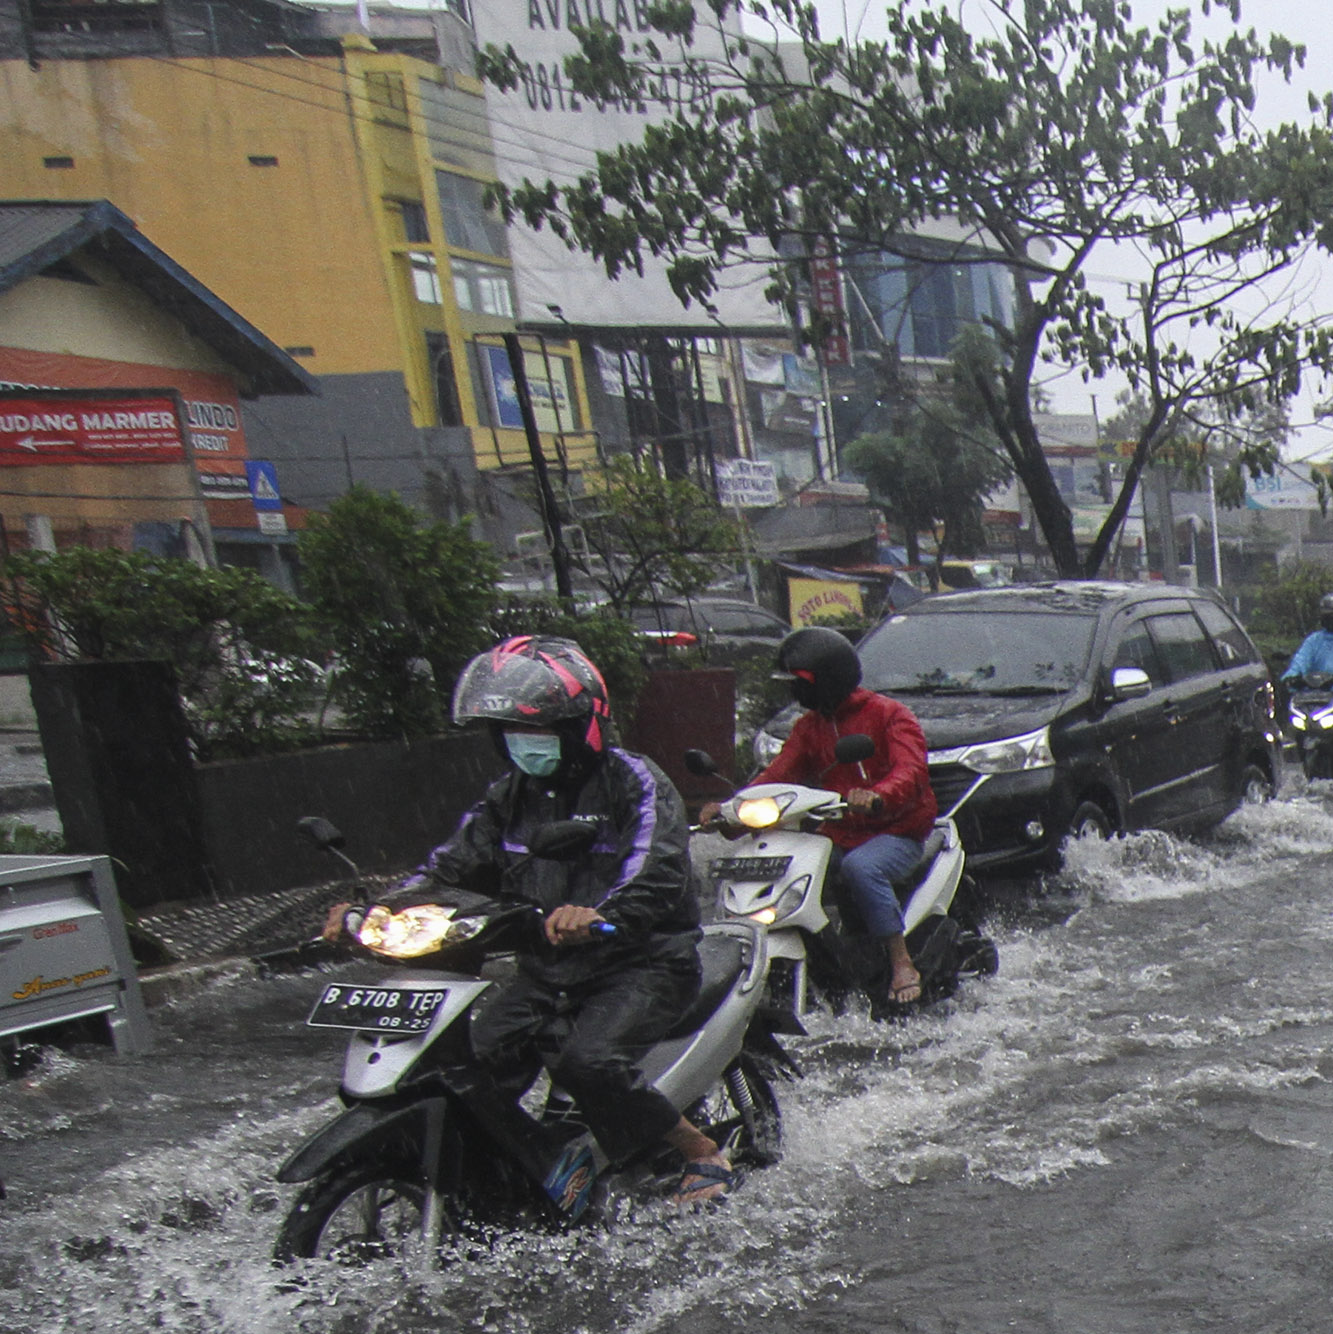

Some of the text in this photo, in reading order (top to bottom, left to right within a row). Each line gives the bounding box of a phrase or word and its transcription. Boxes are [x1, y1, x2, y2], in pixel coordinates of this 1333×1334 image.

[528, 0, 653, 32] AVAILAB
[81, 411, 177, 431] MARMER
[191, 432, 229, 451] KREDIT
[323, 987, 444, 1010] B 6708 TEP
